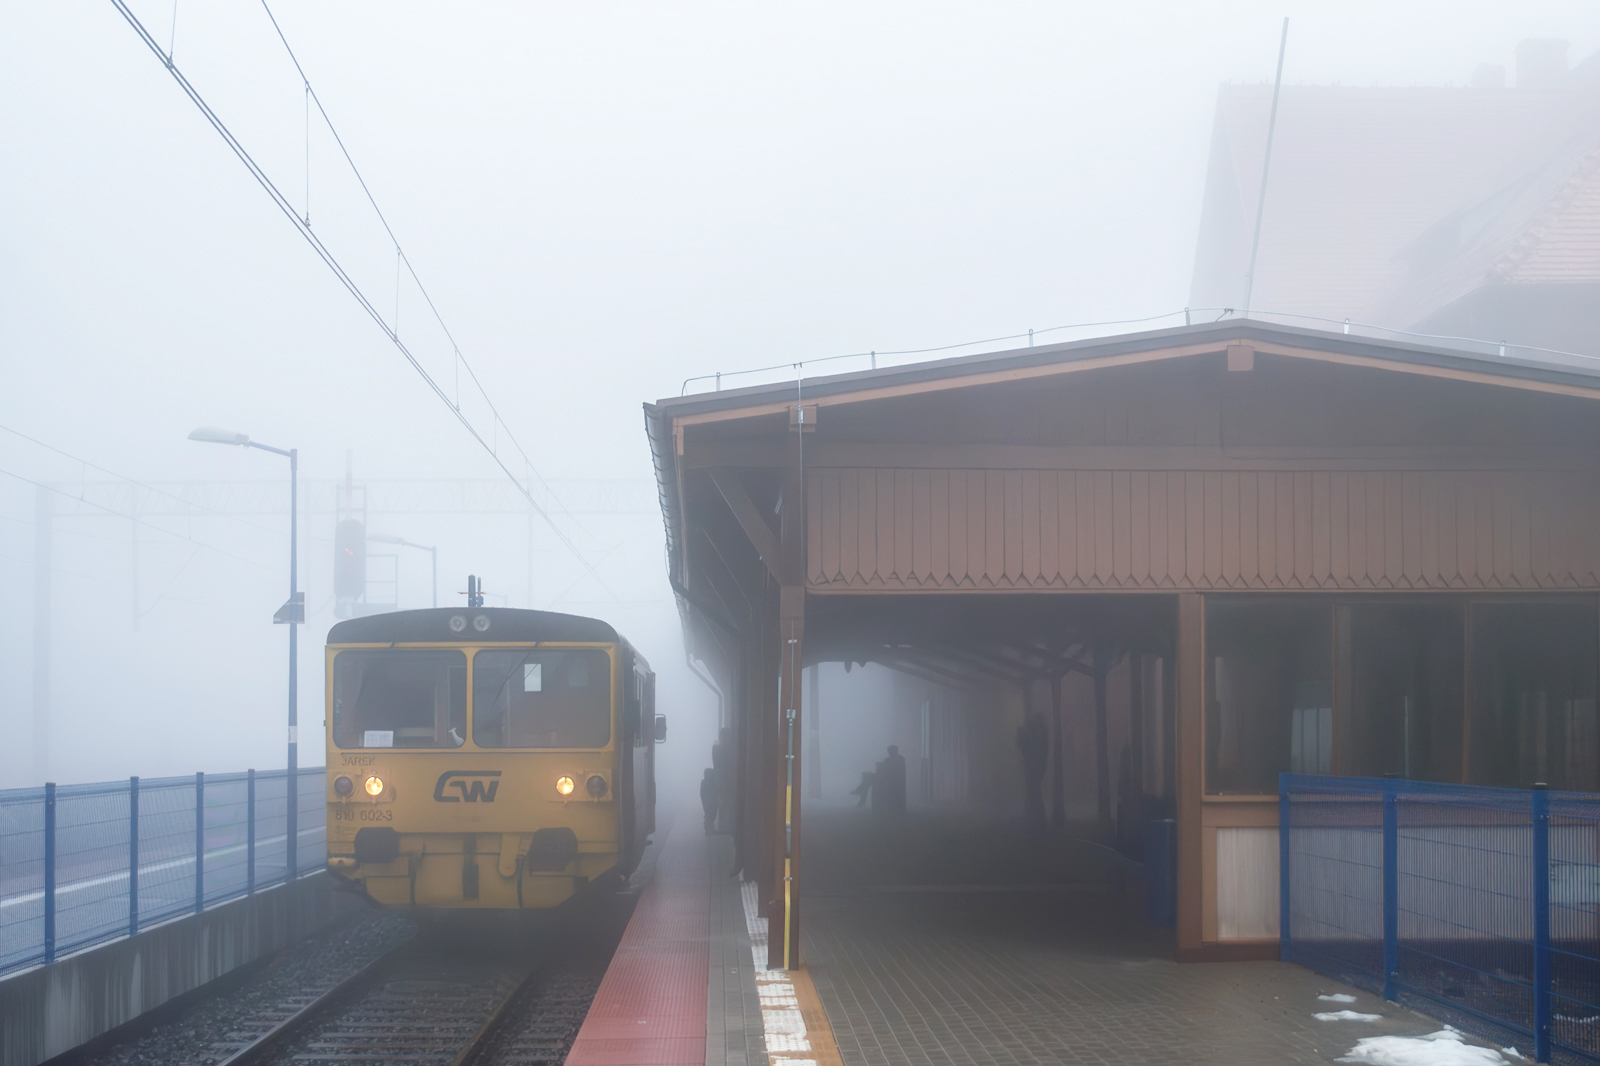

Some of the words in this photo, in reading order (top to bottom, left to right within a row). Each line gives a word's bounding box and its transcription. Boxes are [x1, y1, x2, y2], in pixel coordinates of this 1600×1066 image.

[342, 757, 376, 766] JAREK
[335, 809, 354, 821] 810
[360, 809, 393, 821] 602-3
